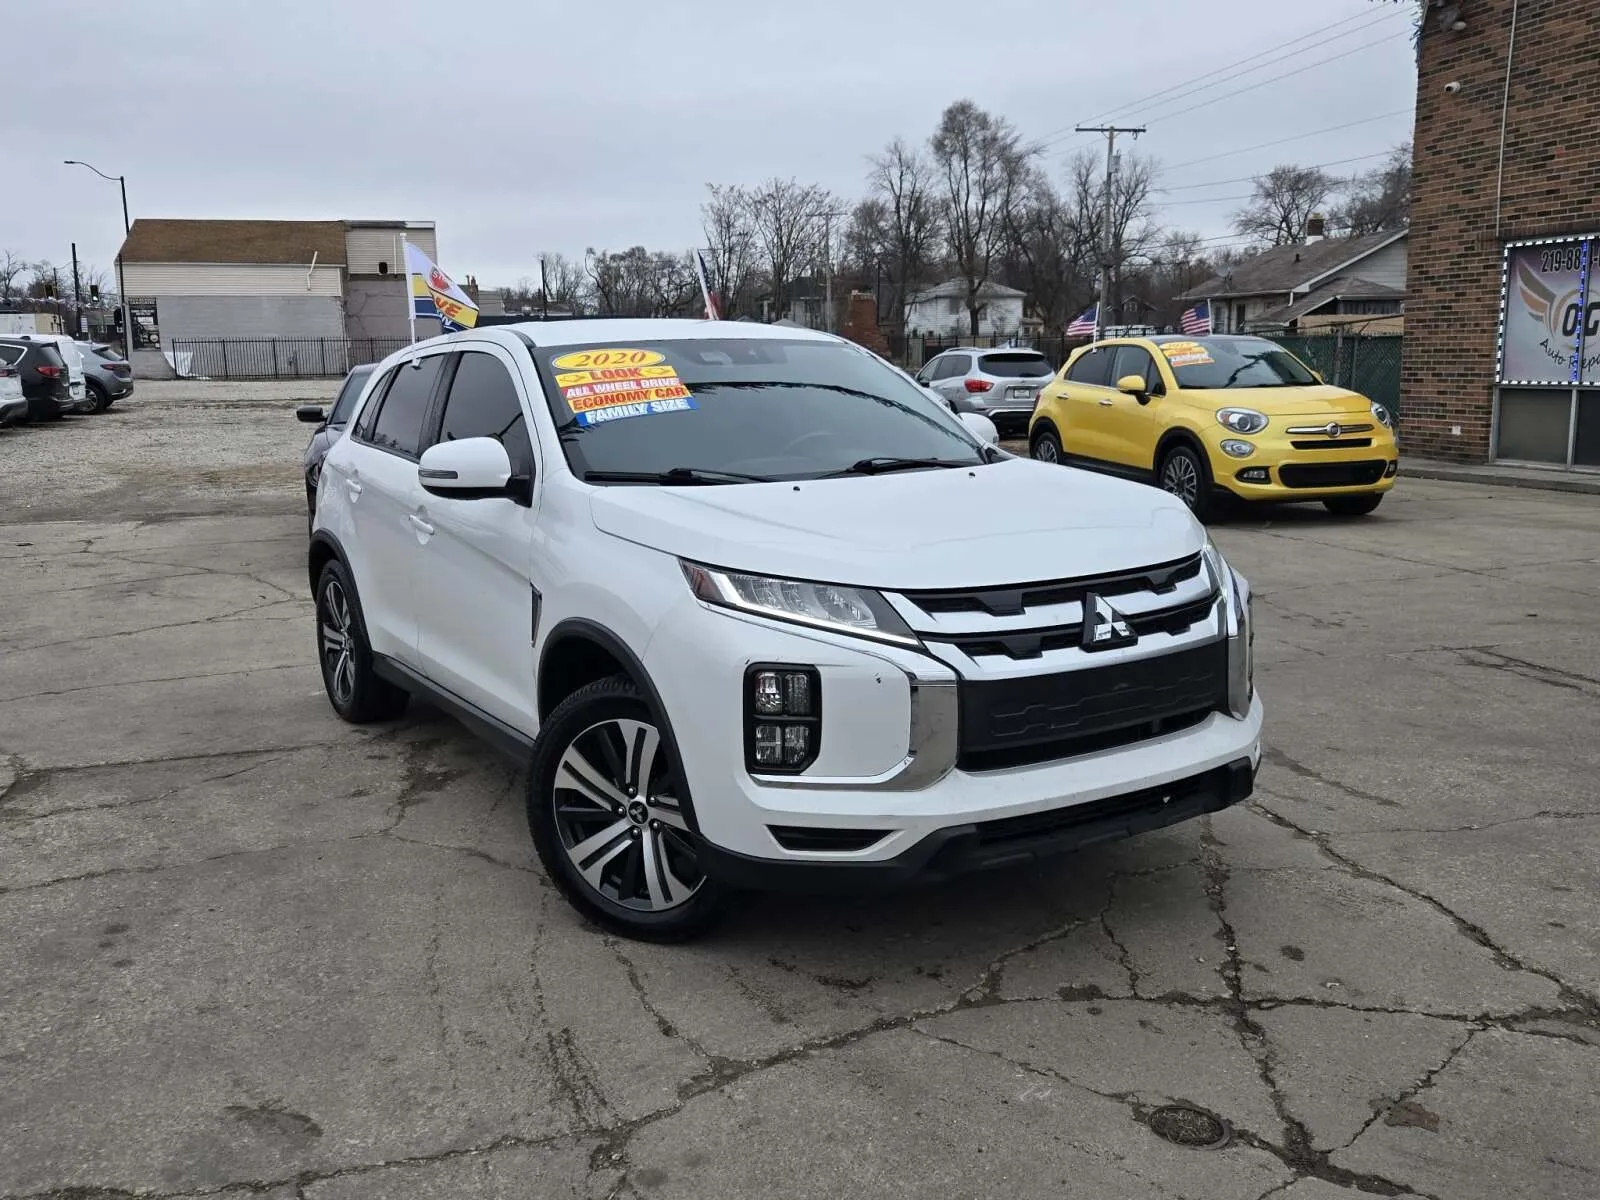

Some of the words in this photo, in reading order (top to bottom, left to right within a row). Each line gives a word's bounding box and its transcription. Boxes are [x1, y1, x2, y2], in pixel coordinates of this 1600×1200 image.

[574, 352, 646, 367] 2020
[1540, 339, 1566, 365] Auto
[590, 368, 640, 380] LOOK
[567, 385, 593, 398] ALL
[593, 380, 640, 394] WHEEL
[640, 378, 680, 389] DRIVE
[573, 390, 651, 410] ECONOMY
[655, 386, 686, 398] CAR
[585, 403, 649, 424] FAMILY
[650, 398, 690, 413] SIZE
